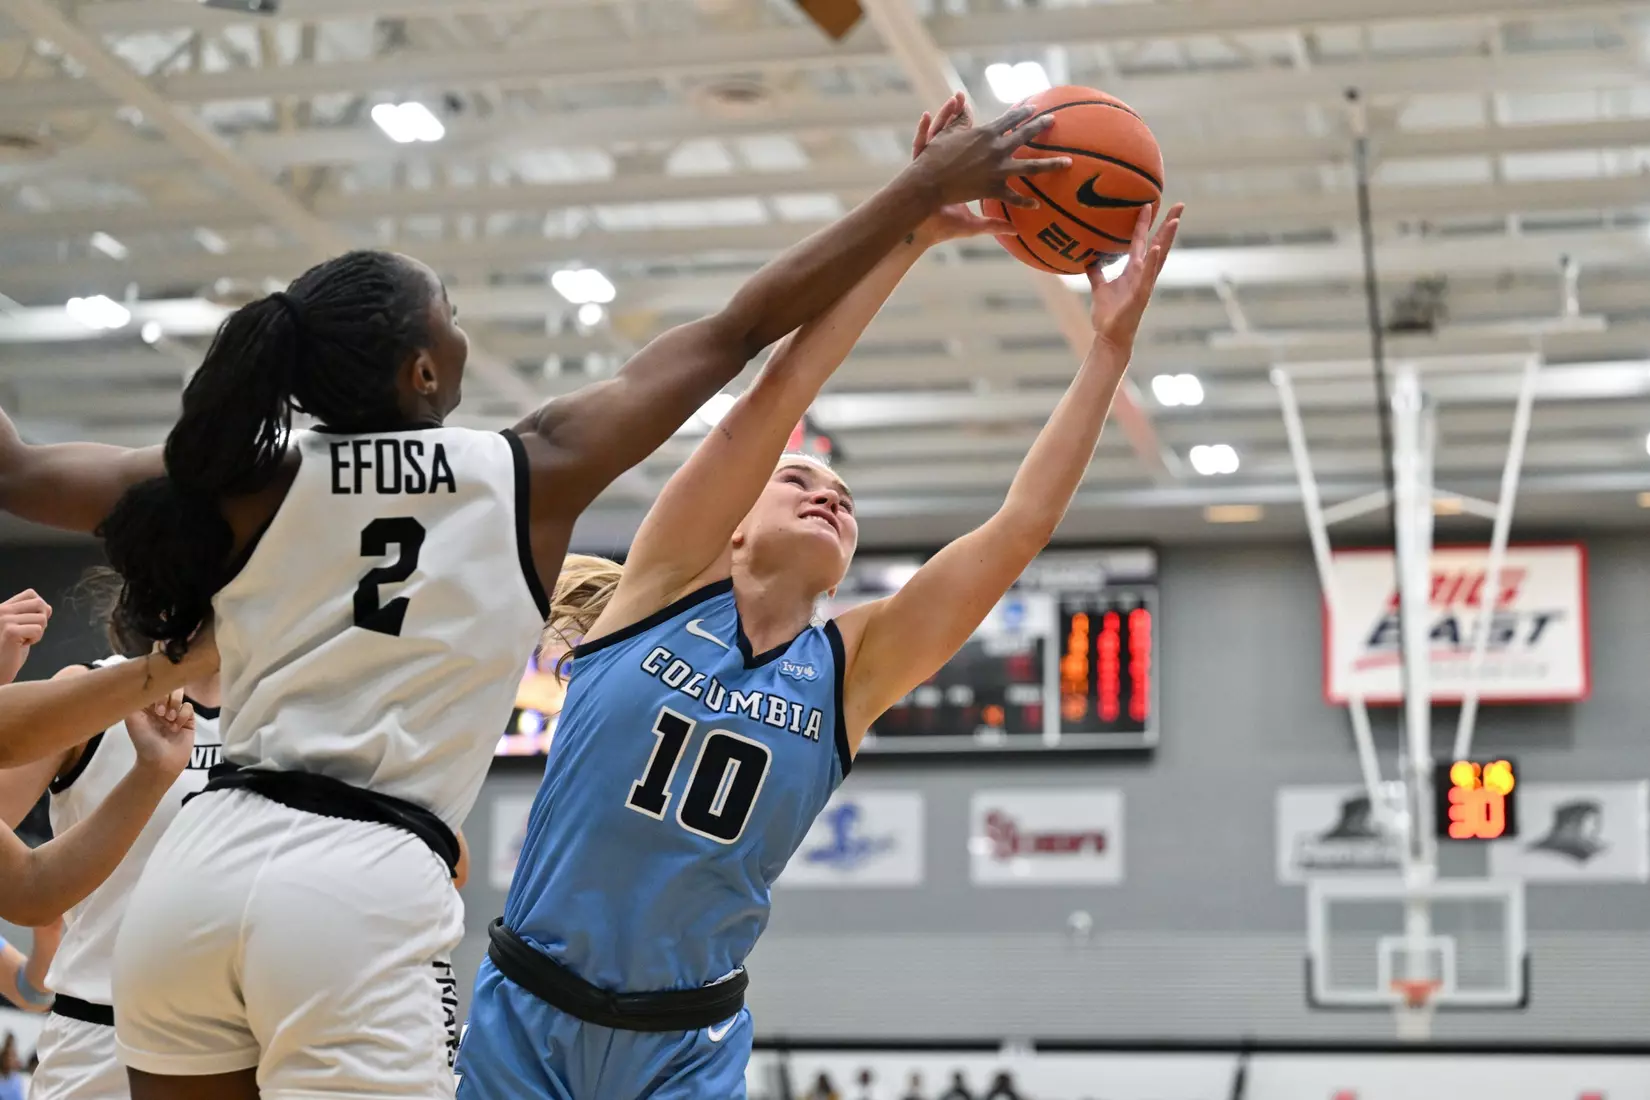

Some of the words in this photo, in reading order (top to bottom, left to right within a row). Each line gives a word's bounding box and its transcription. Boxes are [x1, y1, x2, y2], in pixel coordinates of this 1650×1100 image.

[1037, 222, 1112, 268] ELIT
[330, 439, 456, 494] EFOSA
[353, 516, 426, 637] 2
[640, 645, 824, 743] COLUMBIA
[782, 661, 804, 676] Ivy
[624, 705, 772, 845] 10
